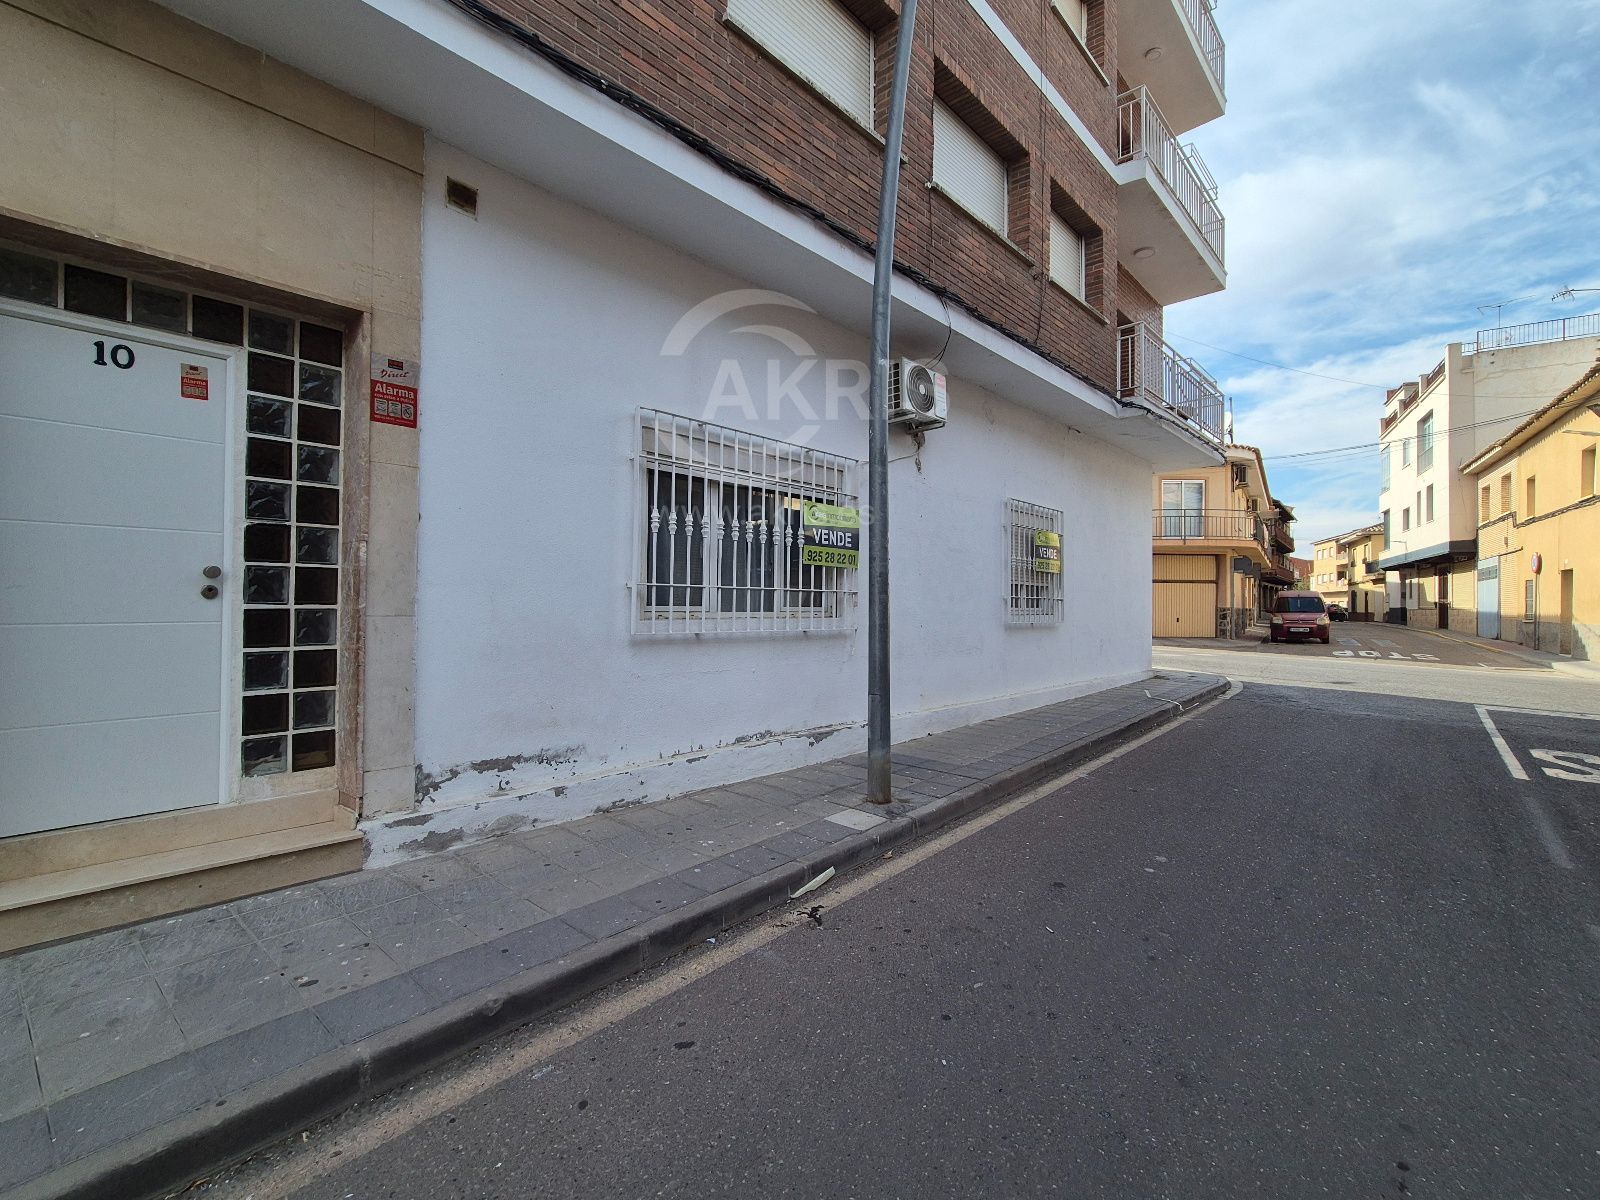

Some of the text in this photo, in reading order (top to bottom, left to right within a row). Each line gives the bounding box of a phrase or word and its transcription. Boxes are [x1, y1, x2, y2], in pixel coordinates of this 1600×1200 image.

[93, 340, 135, 369] 10
[183, 378, 206, 386] Alarma
[375, 383, 414, 398] Alarma
[812, 527, 852, 548] VENDE
[807, 549, 856, 566] 925 28 22 01
[1332, 649, 1441, 661] STOP
